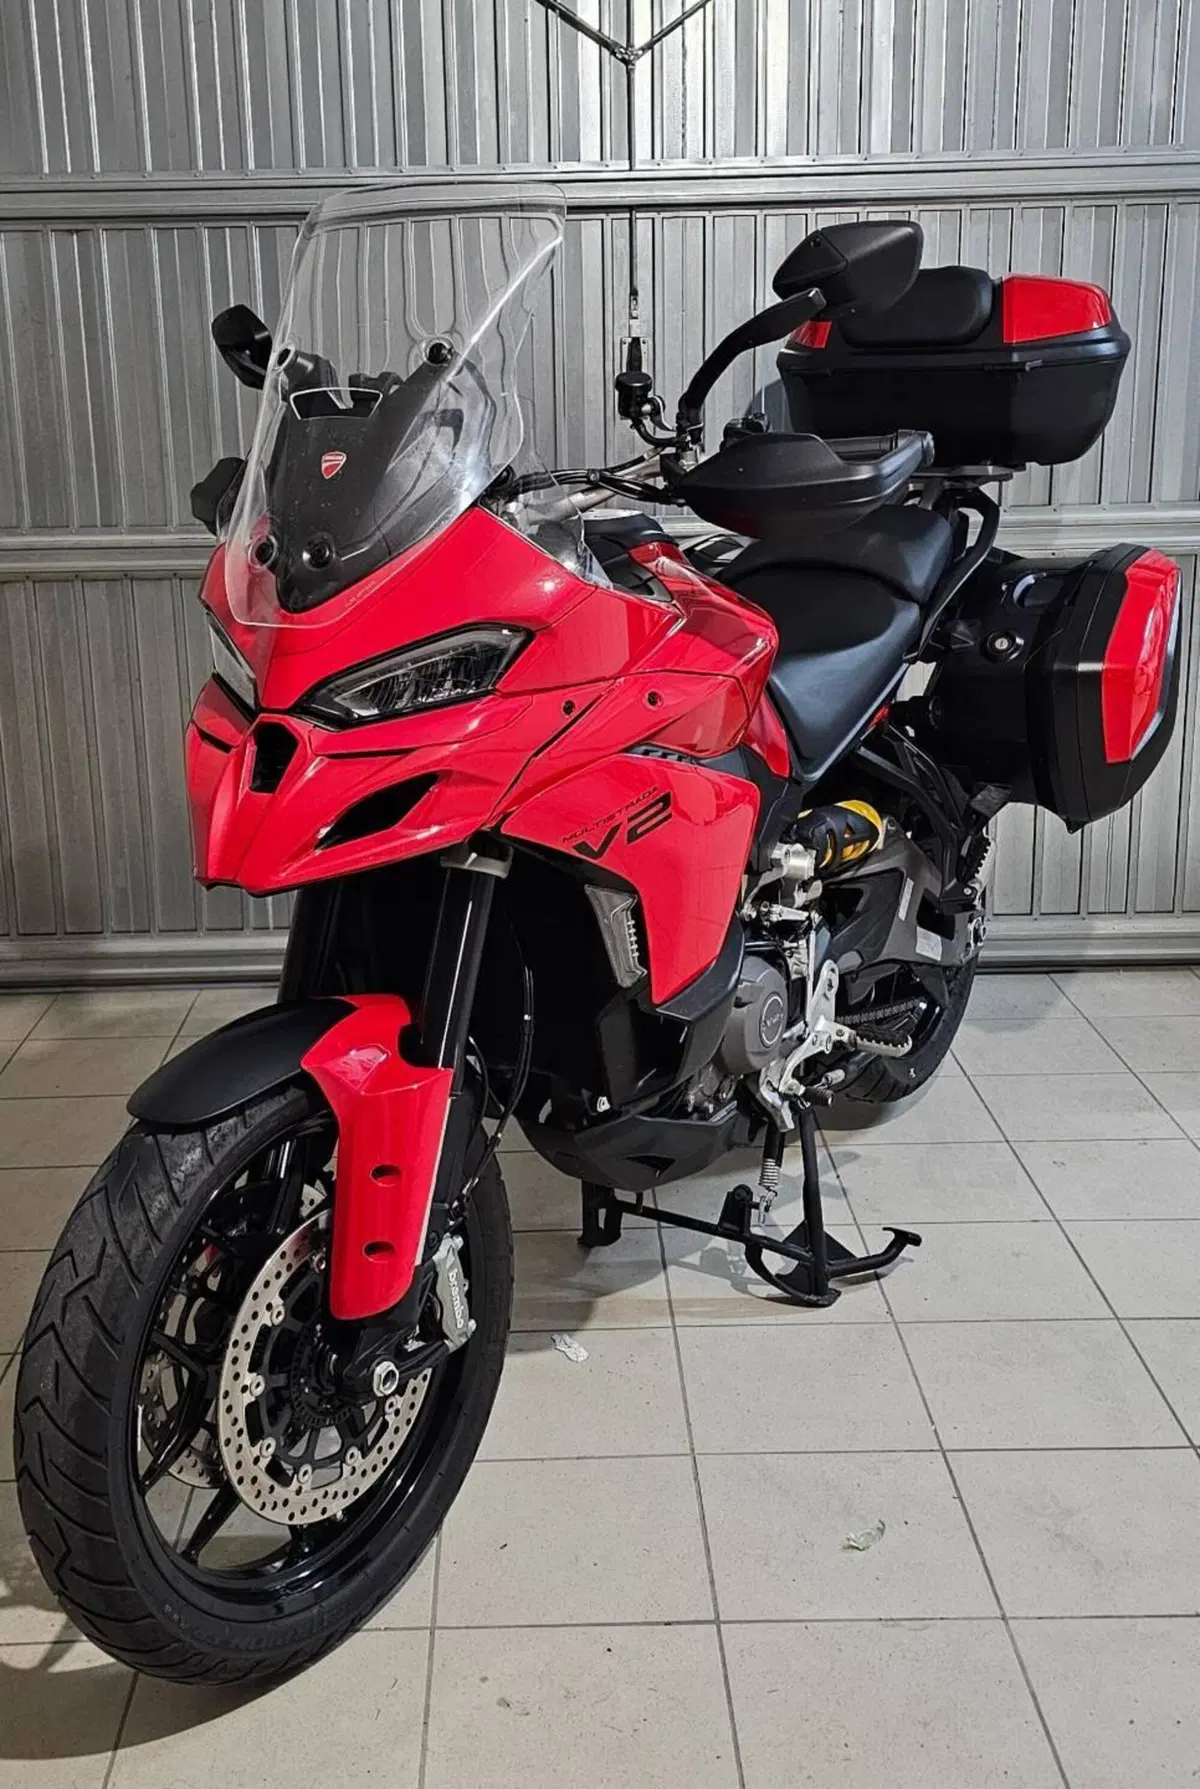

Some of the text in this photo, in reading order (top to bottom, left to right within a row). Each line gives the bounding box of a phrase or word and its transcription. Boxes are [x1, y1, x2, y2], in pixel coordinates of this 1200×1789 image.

[562, 785, 659, 842] MULTISTRADA
[571, 790, 673, 860] V2
[448, 1267, 465, 1329] brembo
